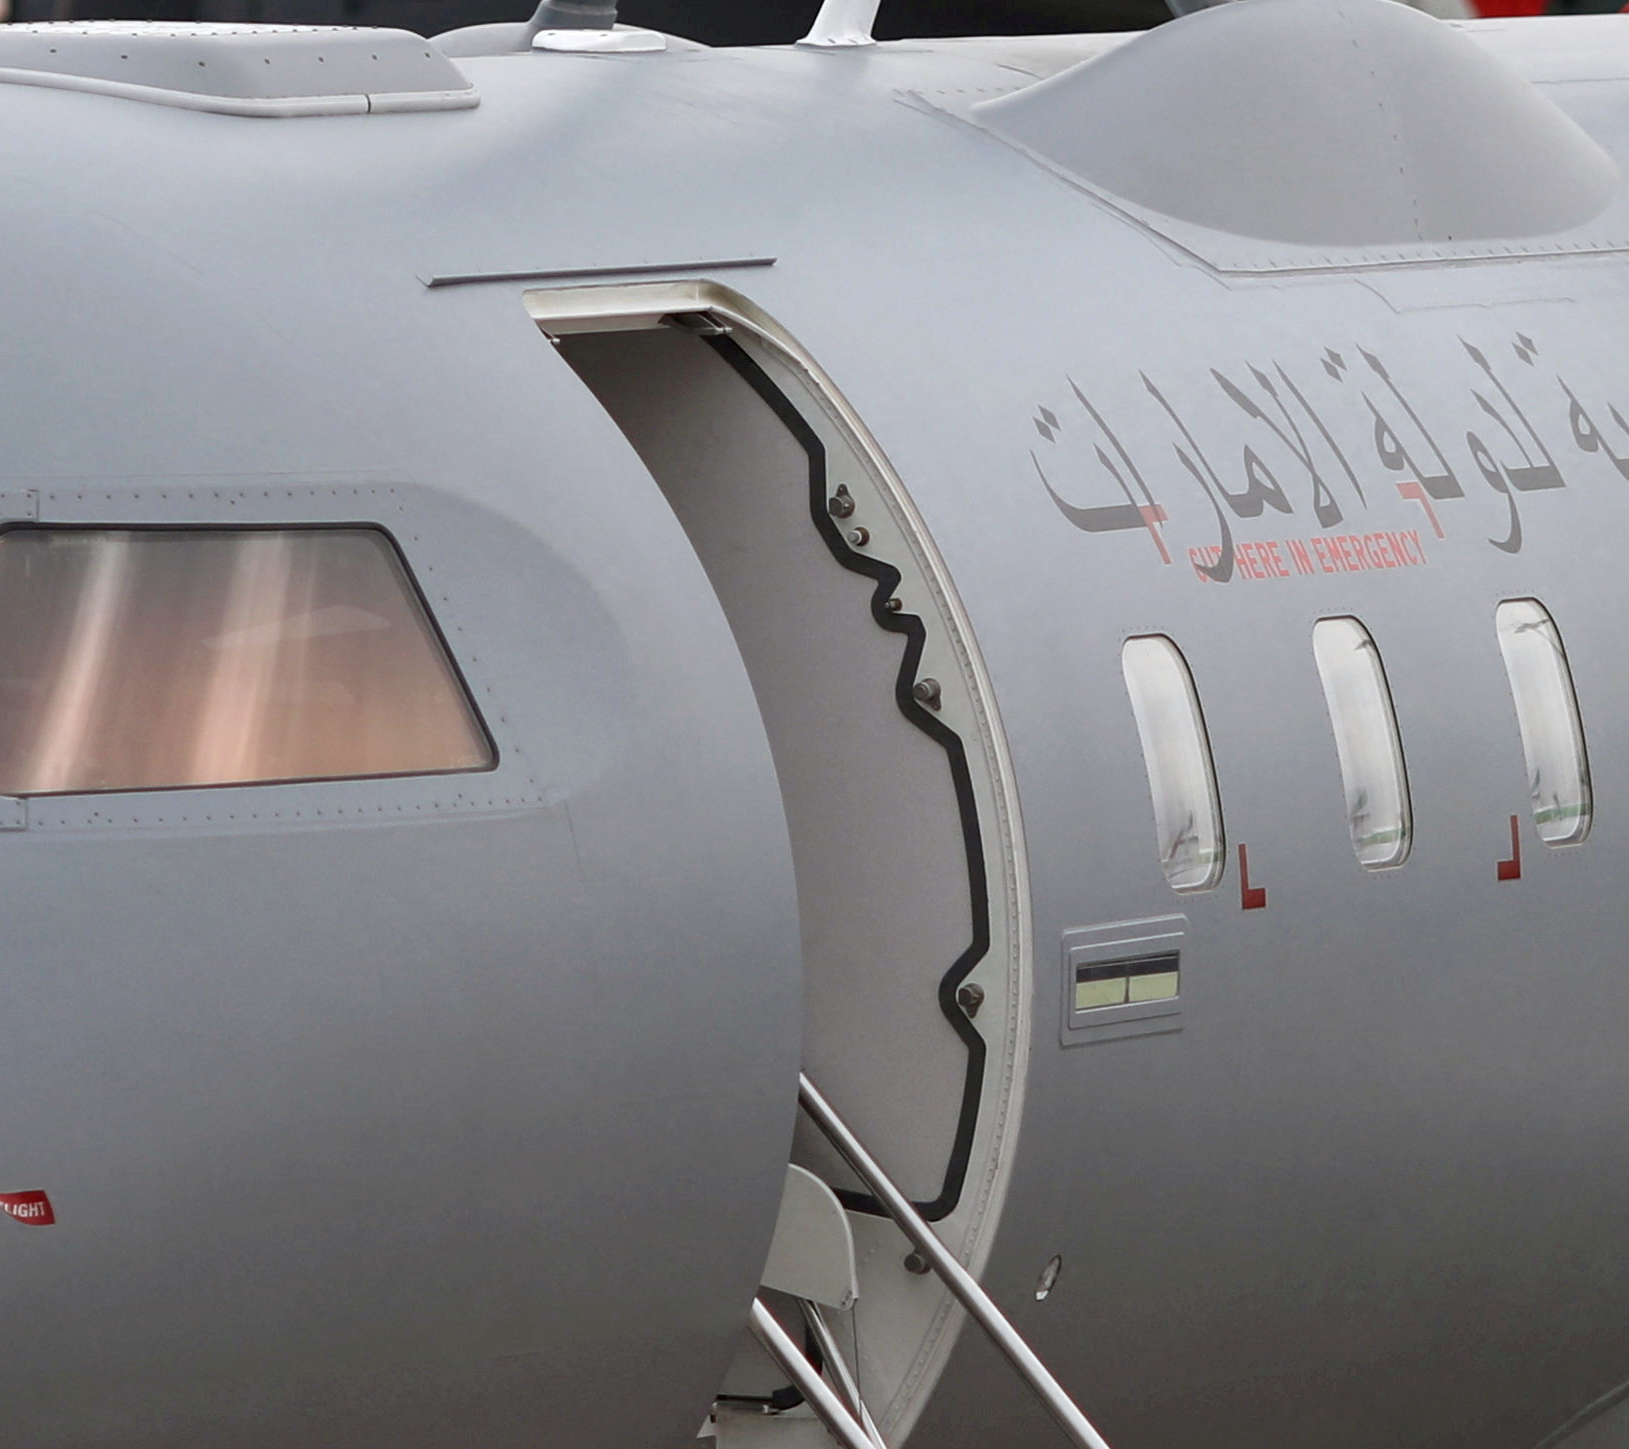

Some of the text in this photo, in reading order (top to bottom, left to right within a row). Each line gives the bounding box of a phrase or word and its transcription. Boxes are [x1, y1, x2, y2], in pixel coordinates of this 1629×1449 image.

[1234, 540, 1291, 580] HERE
[1284, 538, 1316, 575] IN
[1310, 529, 1427, 573] EMERGENCY
